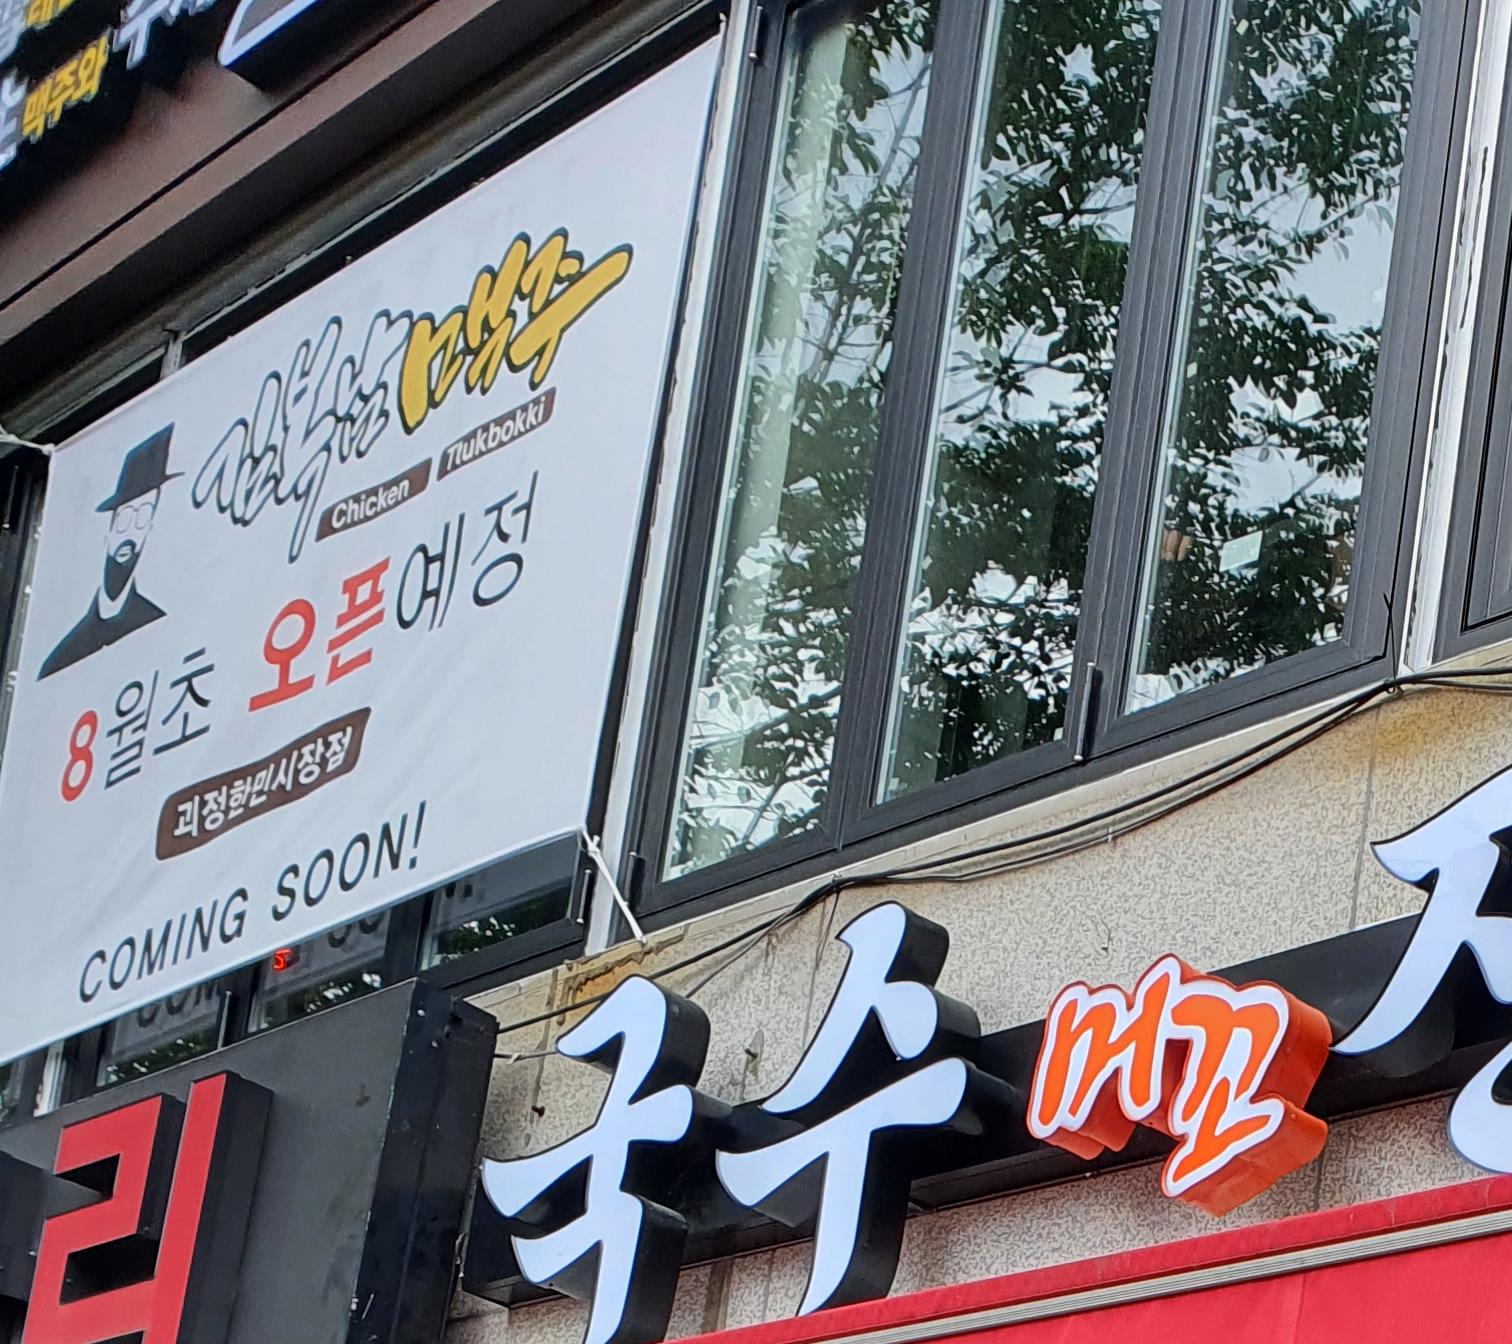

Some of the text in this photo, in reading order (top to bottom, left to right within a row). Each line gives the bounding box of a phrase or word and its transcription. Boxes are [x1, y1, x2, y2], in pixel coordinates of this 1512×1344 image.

[330, 481, 411, 530] Chicken
[61, 645, 216, 803] 8월초
[172, 722, 355, 840] 괴정한민시장점
[79, 886, 249, 1003] COMING
[271, 800, 428, 922] SOON!
